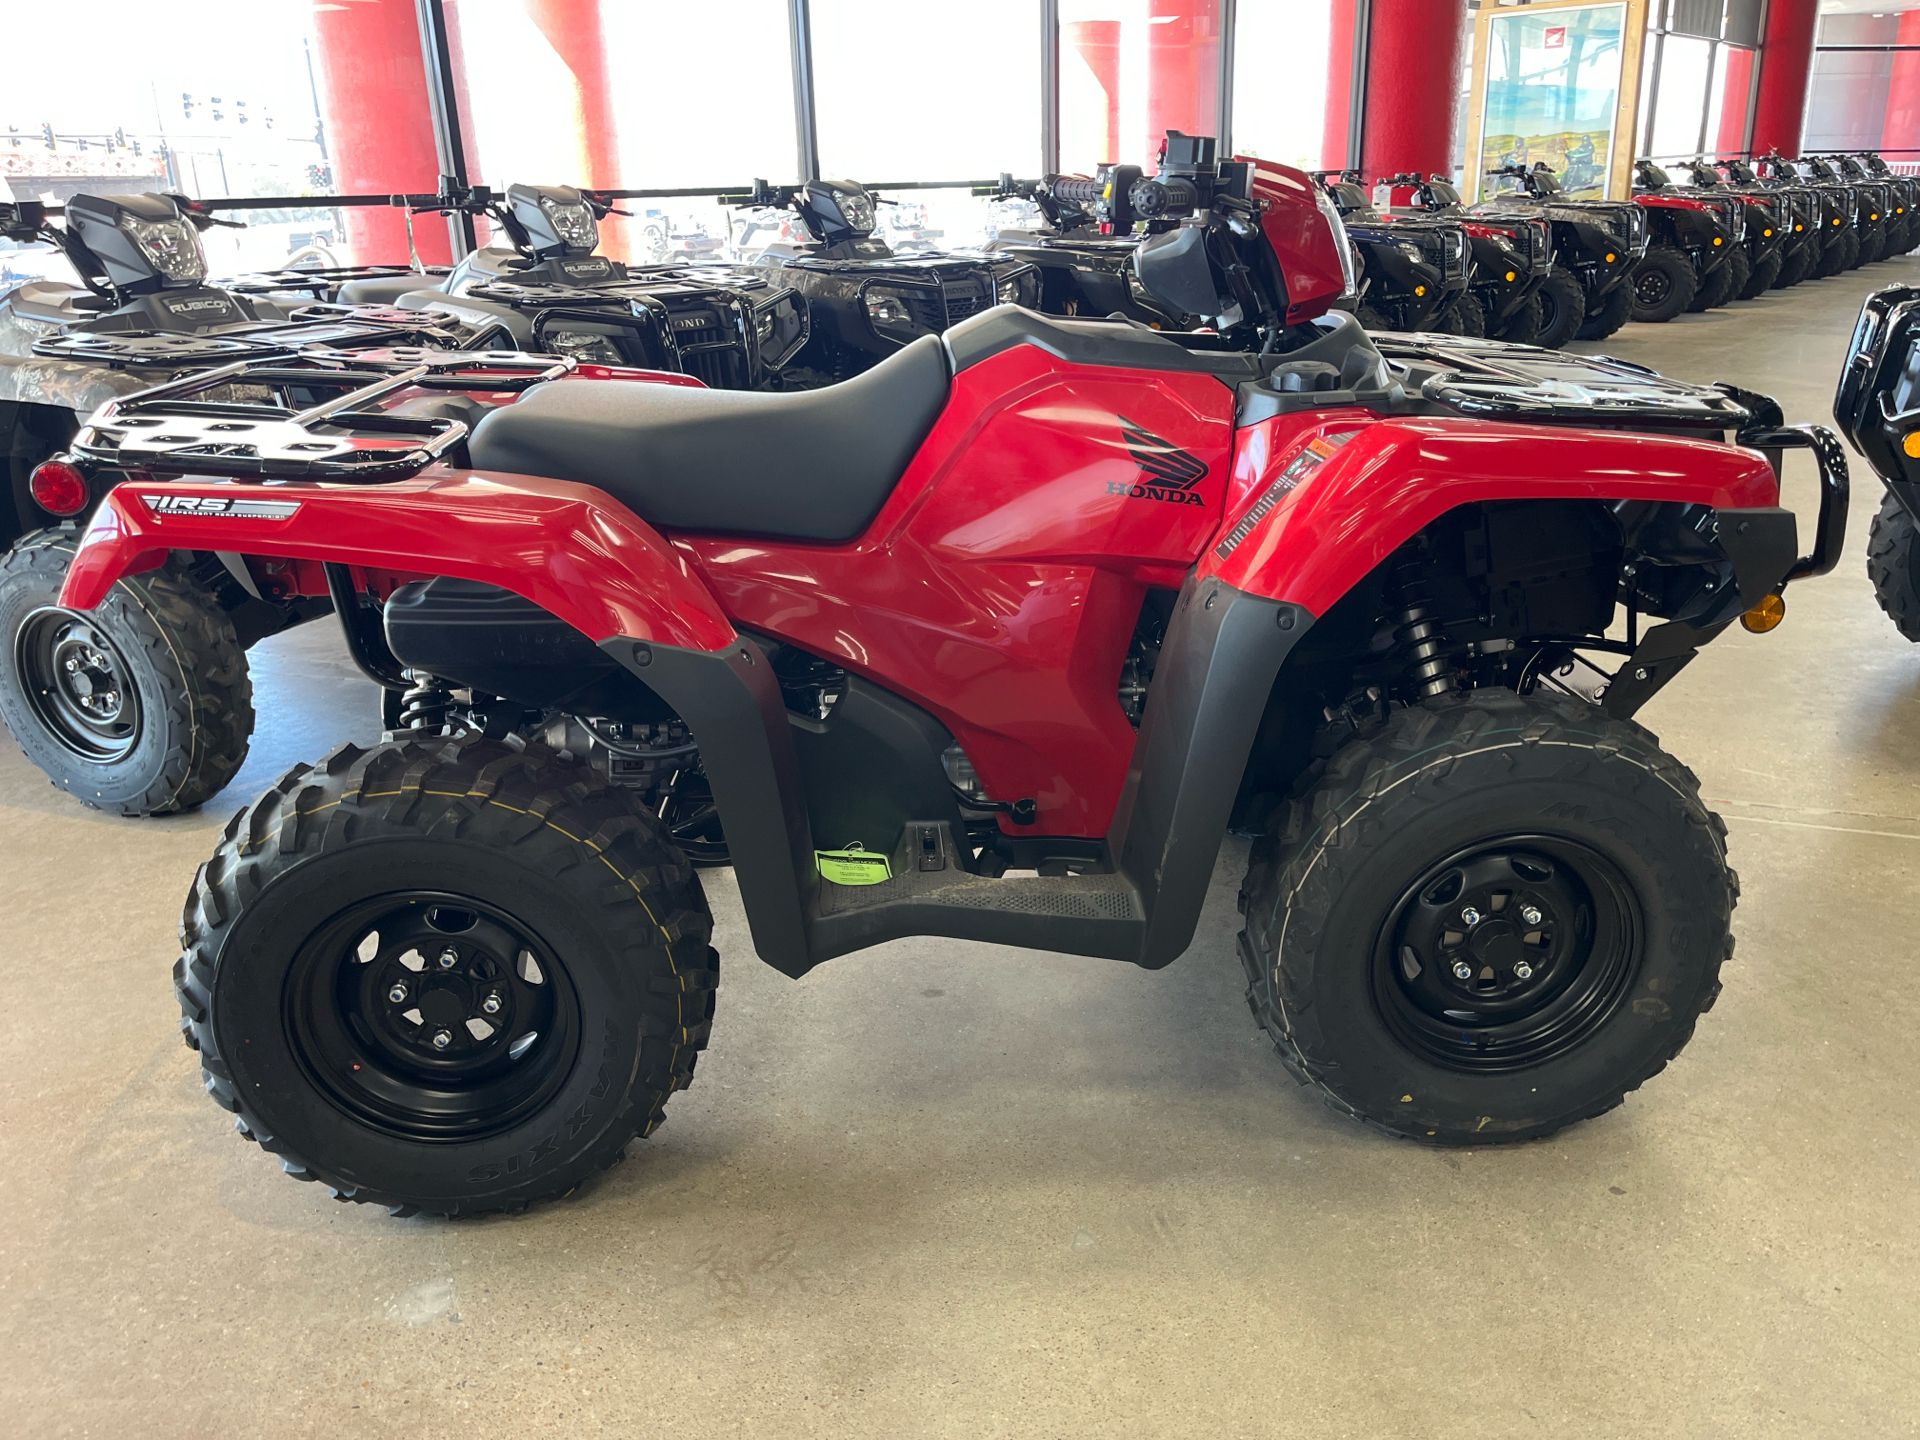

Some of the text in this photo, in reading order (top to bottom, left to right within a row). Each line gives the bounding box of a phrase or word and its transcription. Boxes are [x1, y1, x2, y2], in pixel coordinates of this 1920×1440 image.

[564, 263, 610, 273] RUBICON
[169, 300, 233, 314] RUBICON
[1106, 481, 1206, 507] HONDA
[158, 496, 230, 511] IRS
[466, 1017, 620, 1183] MAXXIS
